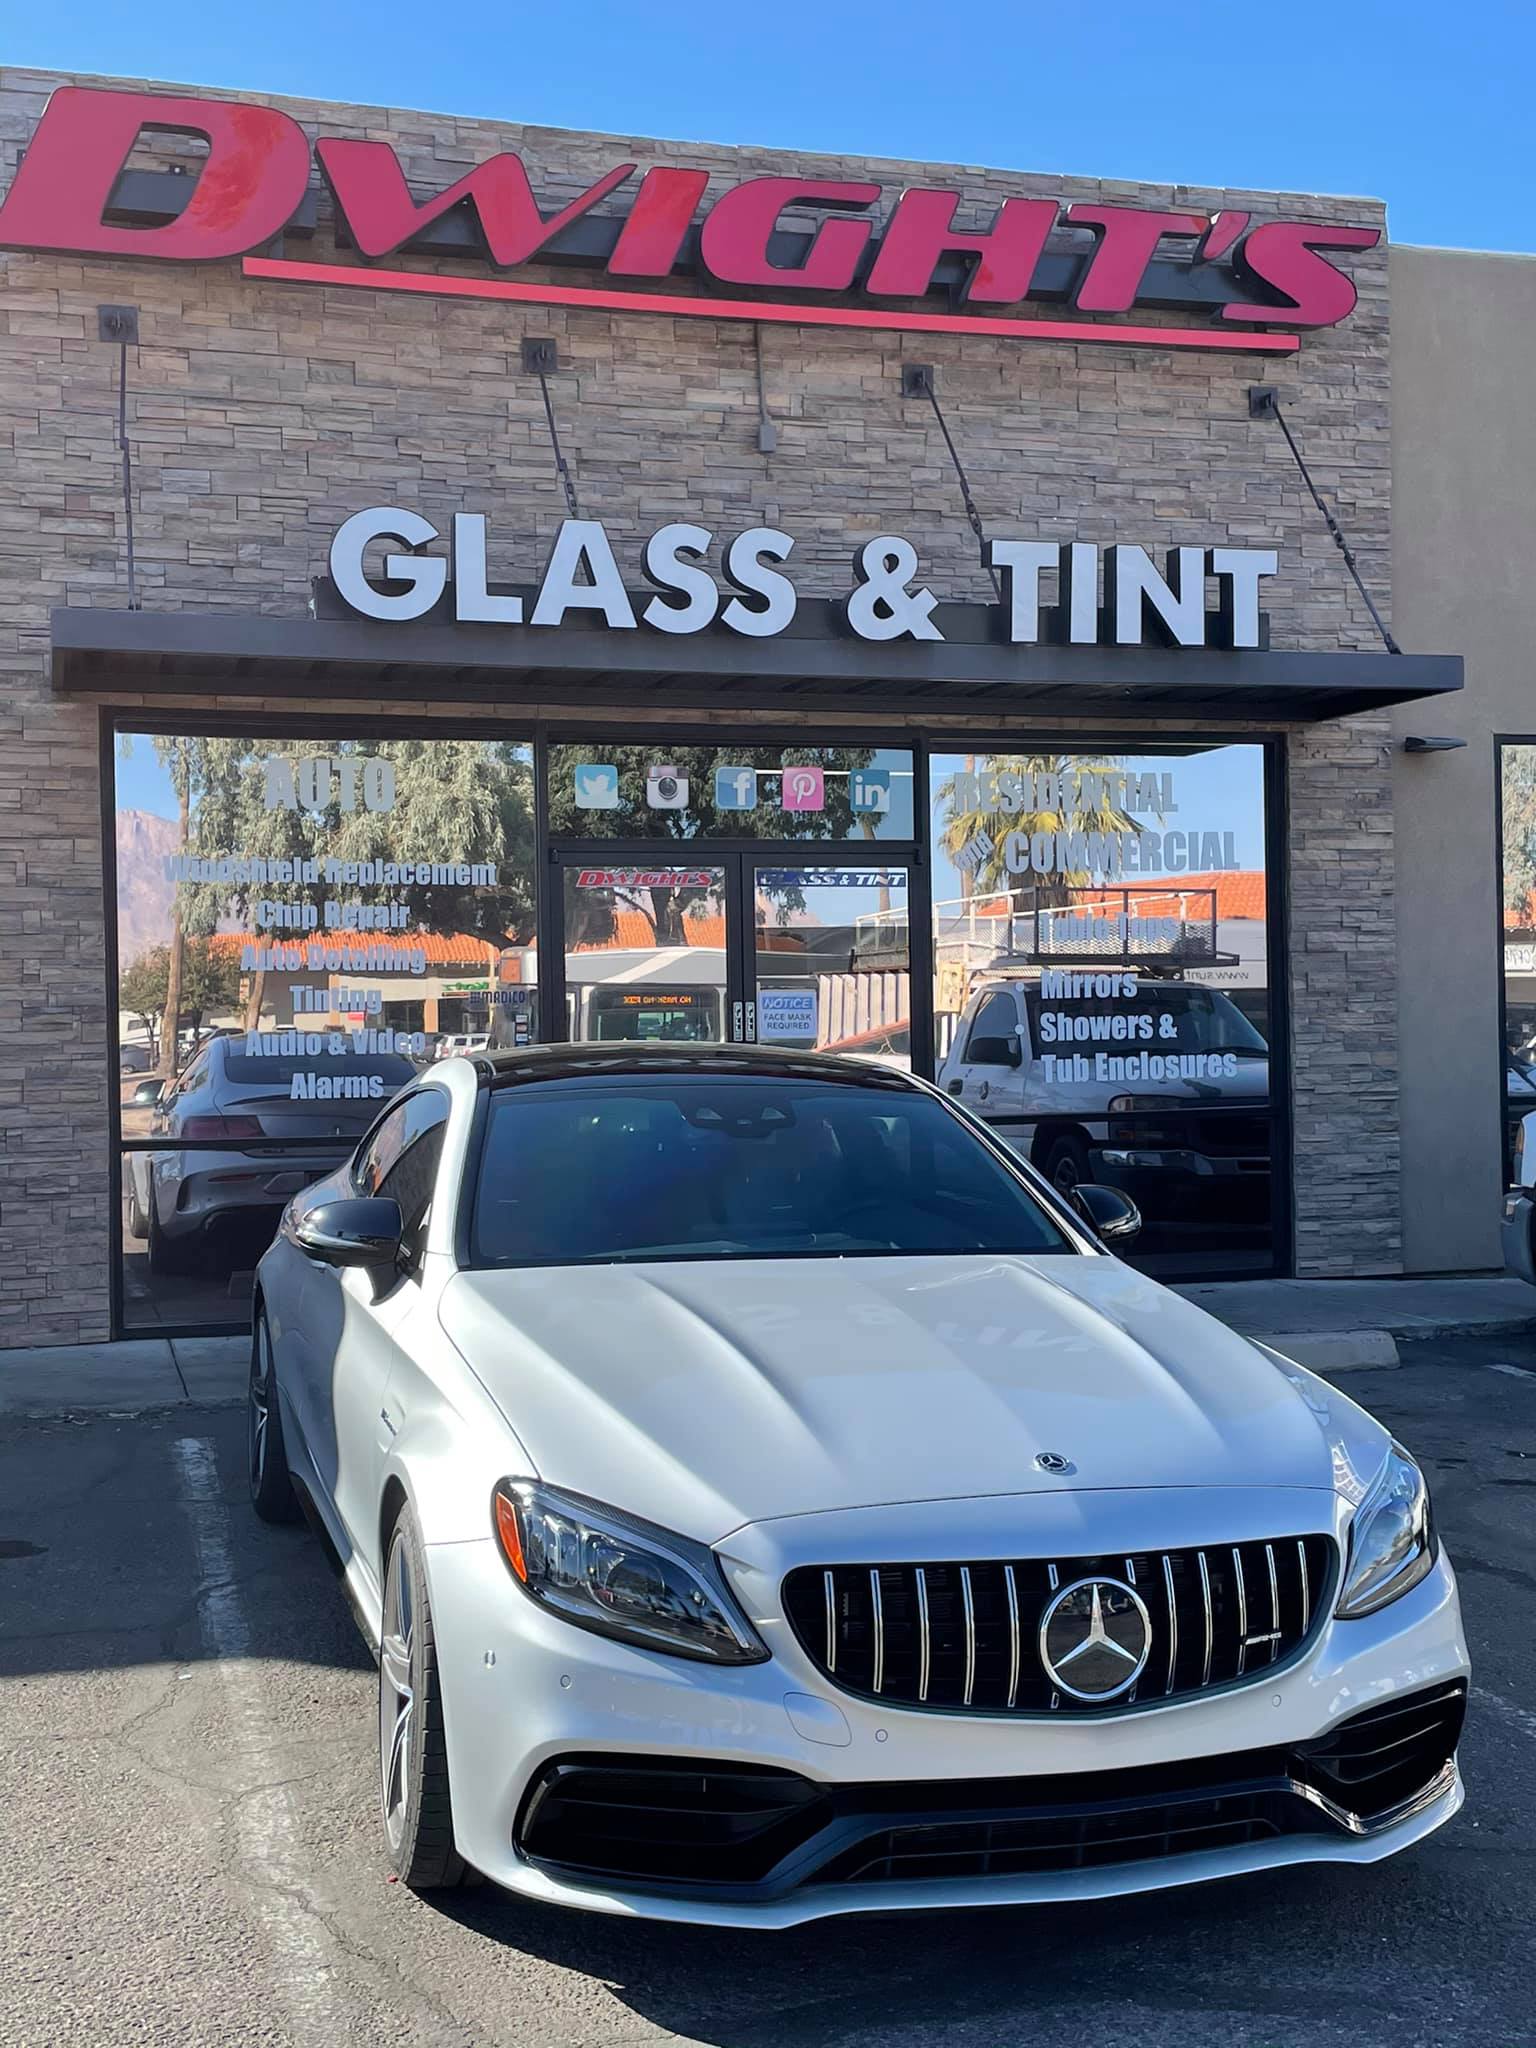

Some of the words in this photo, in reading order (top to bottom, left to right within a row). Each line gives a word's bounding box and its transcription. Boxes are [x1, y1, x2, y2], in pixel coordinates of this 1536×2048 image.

[0, 86, 1380, 328] DWIGHT'S
[330, 506, 796, 638] GLASS
[846, 536, 945, 643] &
[989, 540, 1278, 648] TINT
[264, 758, 397, 812] AUTO
[954, 771, 1178, 813] RESIDENTIAL
[1005, 831, 1240, 873] COMMERCIAL
[163, 855, 319, 884] Windshield
[325, 857, 498, 887] Replacement
[577, 870, 713, 887] DWIGHT'S
[840, 874, 850, 886] &
[856, 874, 905, 886] TINT
[257, 900, 319, 929] Chip
[325, 901, 411, 929] Repair
[240, 944, 300, 972] Auto
[308, 943, 427, 975] Detailing
[289, 985, 383, 1015] Tinting
[1040, 970, 1138, 1000] Mirrors
[763, 997, 811, 1009] NOTICE
[763, 1013, 785, 1021] FACE
[788, 1013, 812, 1021] MASK
[767, 1022, 810, 1030] REQUIRED
[1039, 1012, 1154, 1042] Showers
[1159, 1013, 1178, 1039] &
[245, 1030, 321, 1057] Audio
[328, 1030, 347, 1056] &
[351, 1028, 425, 1056] Video
[1040, 1053, 1090, 1083] Tub
[1095, 1051, 1238, 1082] Enclosures
[290, 1072, 384, 1100] Alarms
